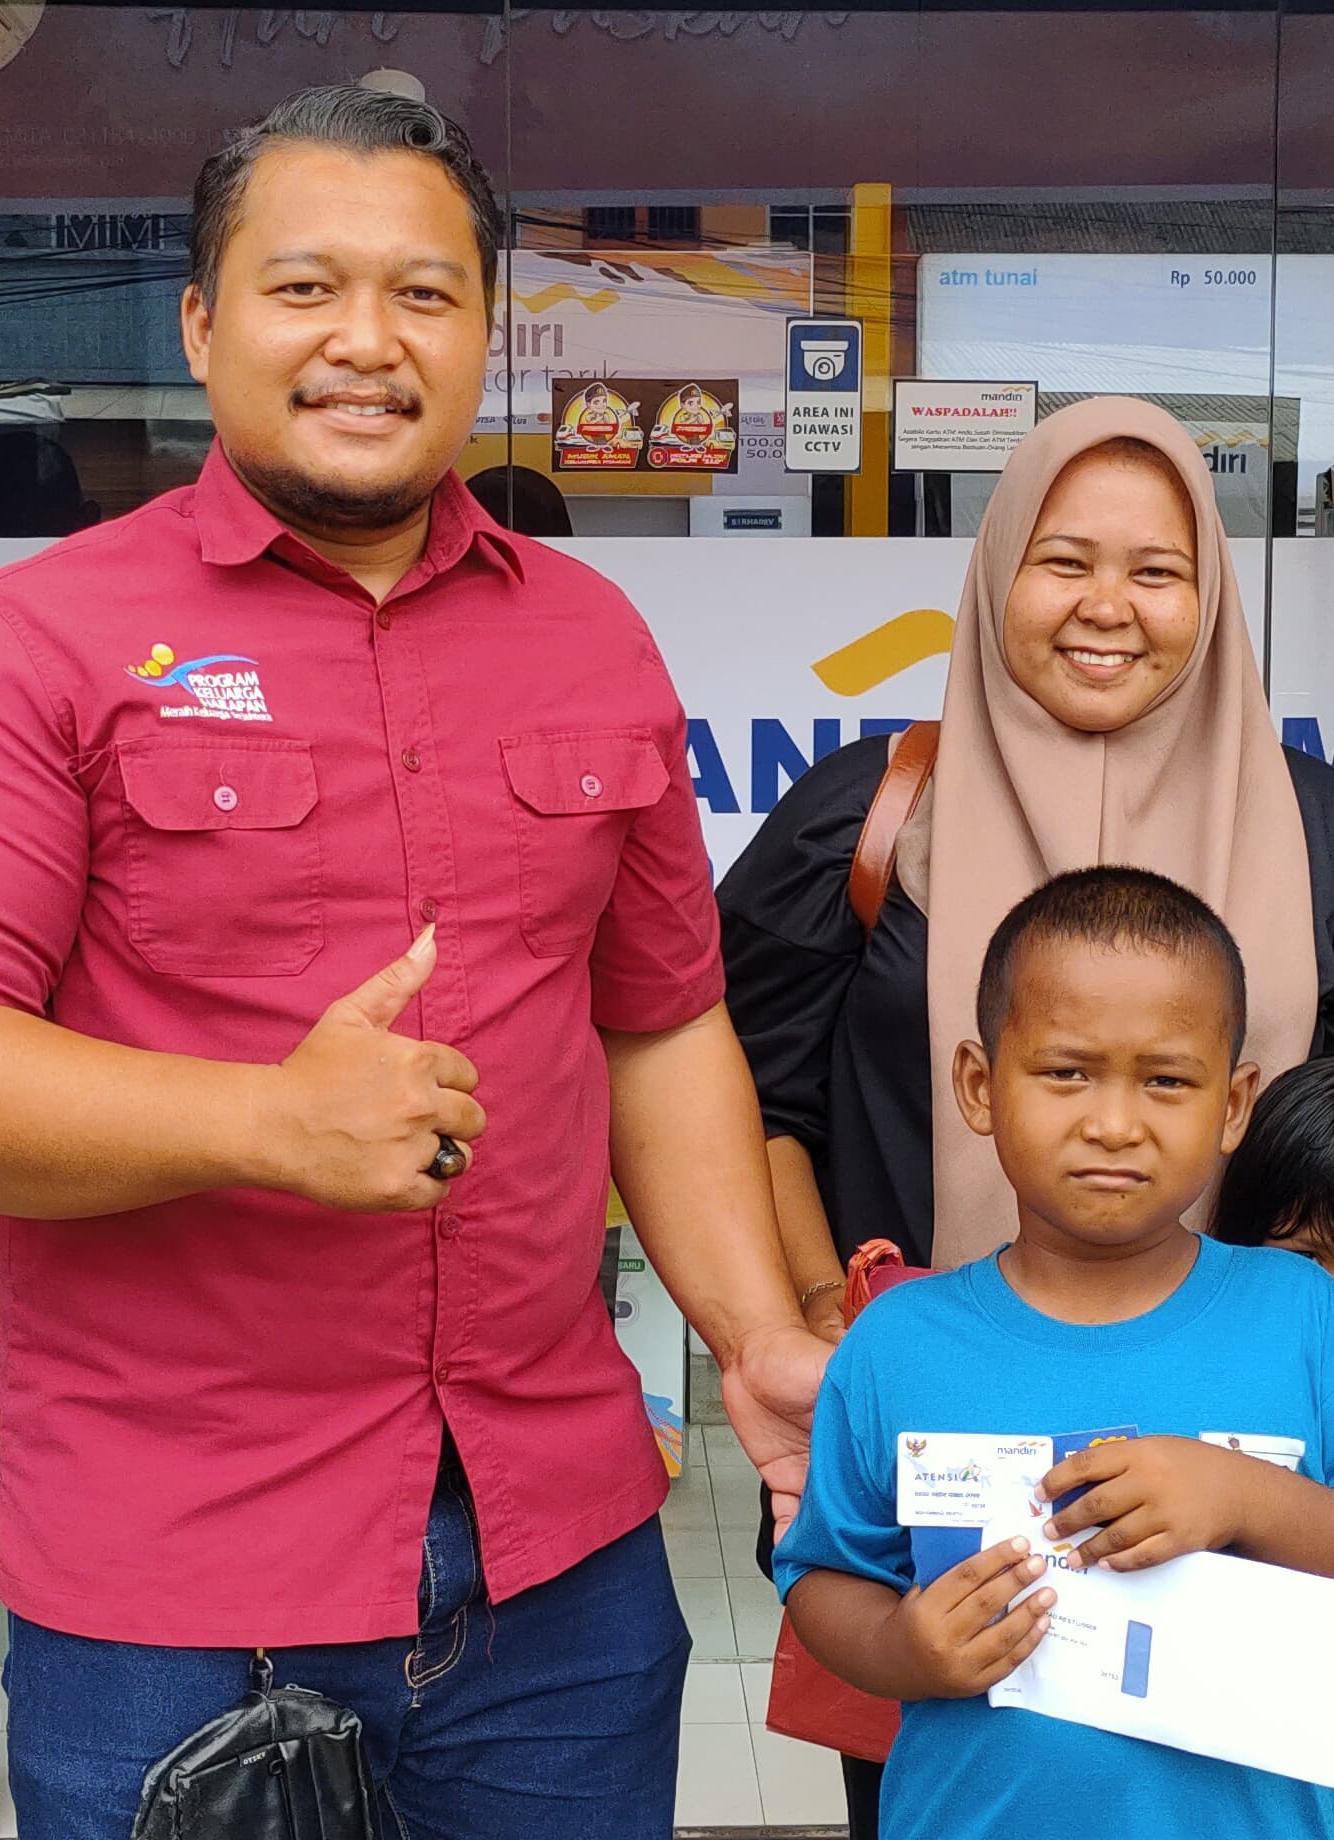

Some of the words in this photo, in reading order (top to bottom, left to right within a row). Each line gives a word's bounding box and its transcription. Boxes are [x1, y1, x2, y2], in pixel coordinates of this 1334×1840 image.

[939, 270, 978, 286] atm
[985, 268, 1038, 286] tunai
[1170, 270, 1190, 288] Rp
[1203, 270, 1257, 286] 50.000
[488, 311, 564, 358] diri
[483, 367, 531, 393] tor
[792, 406, 830, 418] AREA
[834, 407, 854, 418] INI
[792, 424, 854, 436] DIAWASI
[804, 441, 842, 453] CCTV
[1202, 446, 1247, 474] diri
[187, 671, 259, 687] PROGRAM
[193, 686, 264, 700] KELUARGA
[198, 697, 268, 713] HARAPAN
[997, 1446, 1037, 1456] mandiri
[914, 1472, 958, 1482] ATENSI
